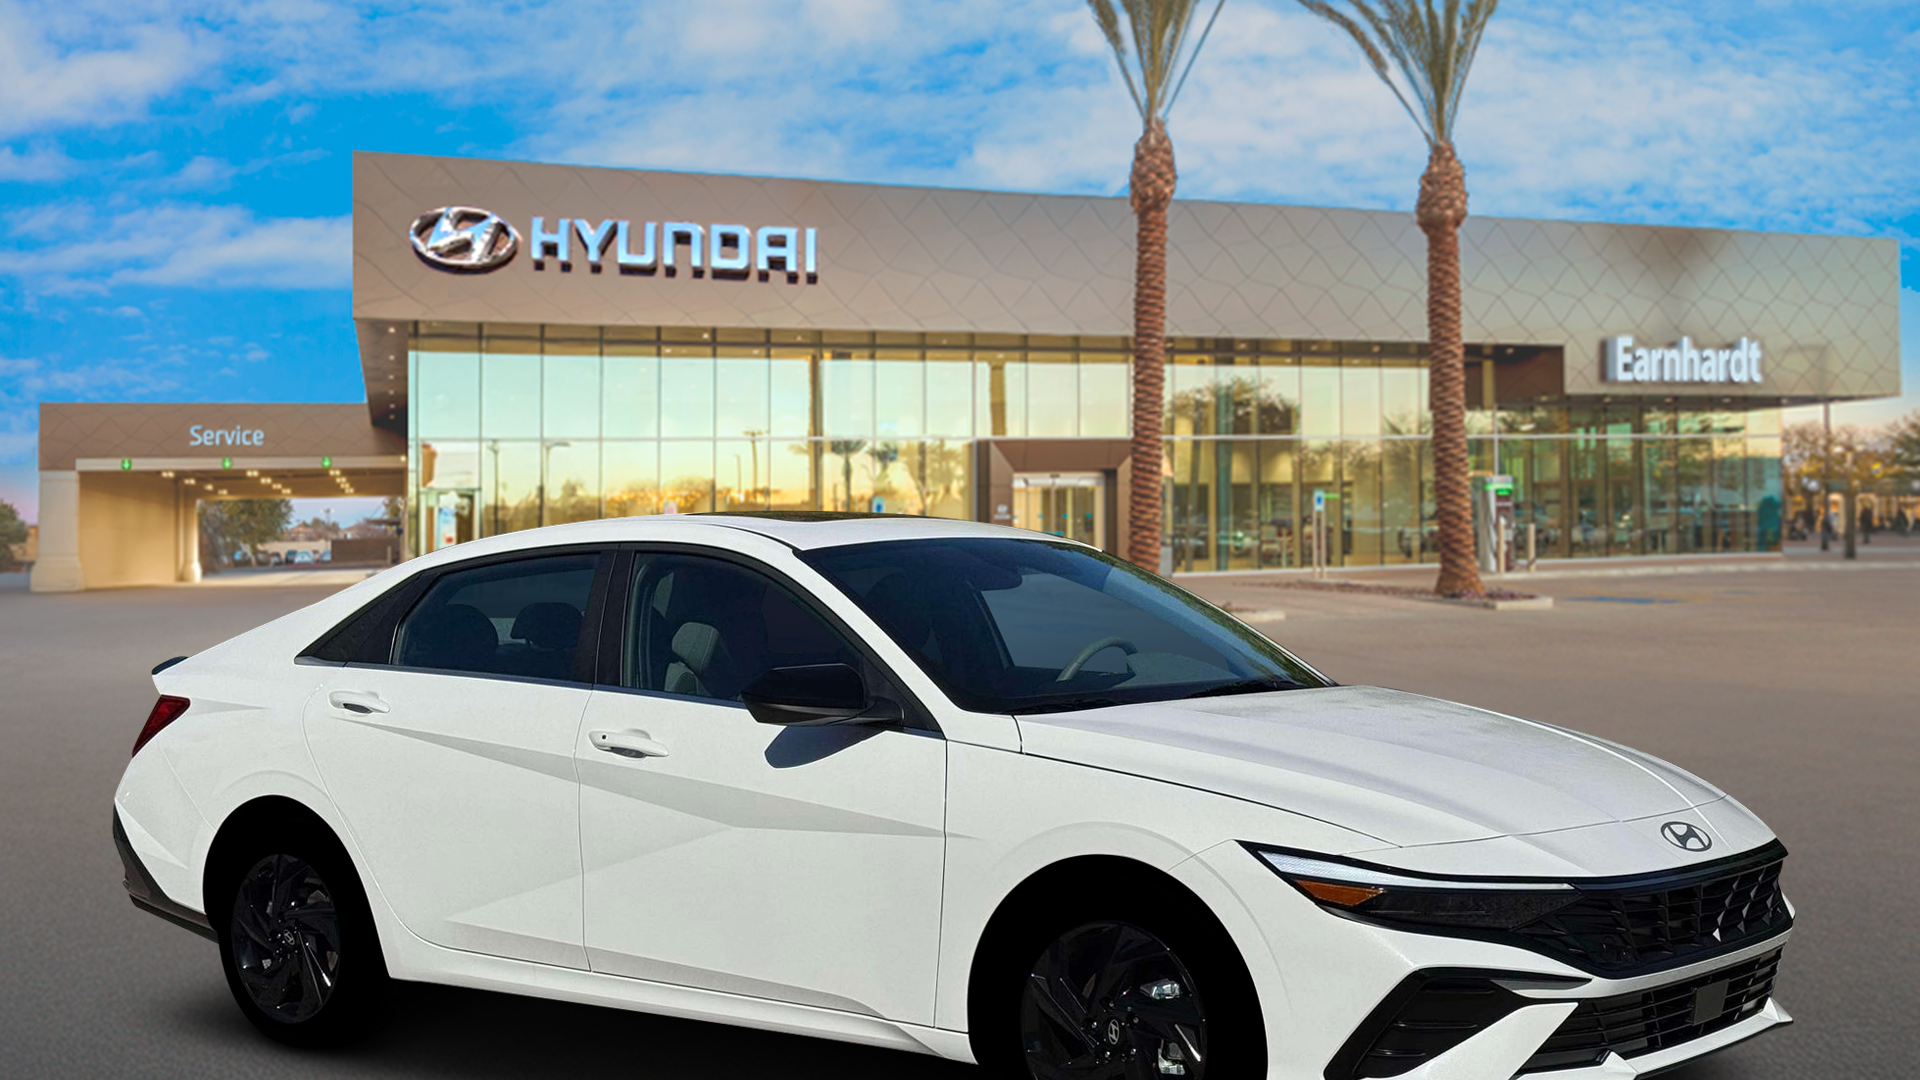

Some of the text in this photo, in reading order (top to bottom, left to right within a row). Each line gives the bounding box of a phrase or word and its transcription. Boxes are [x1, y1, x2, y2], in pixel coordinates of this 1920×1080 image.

[531, 216, 818, 282] HYUNDAI
[1612, 335, 1762, 382] Earnhardt
[189, 425, 264, 446] Service
